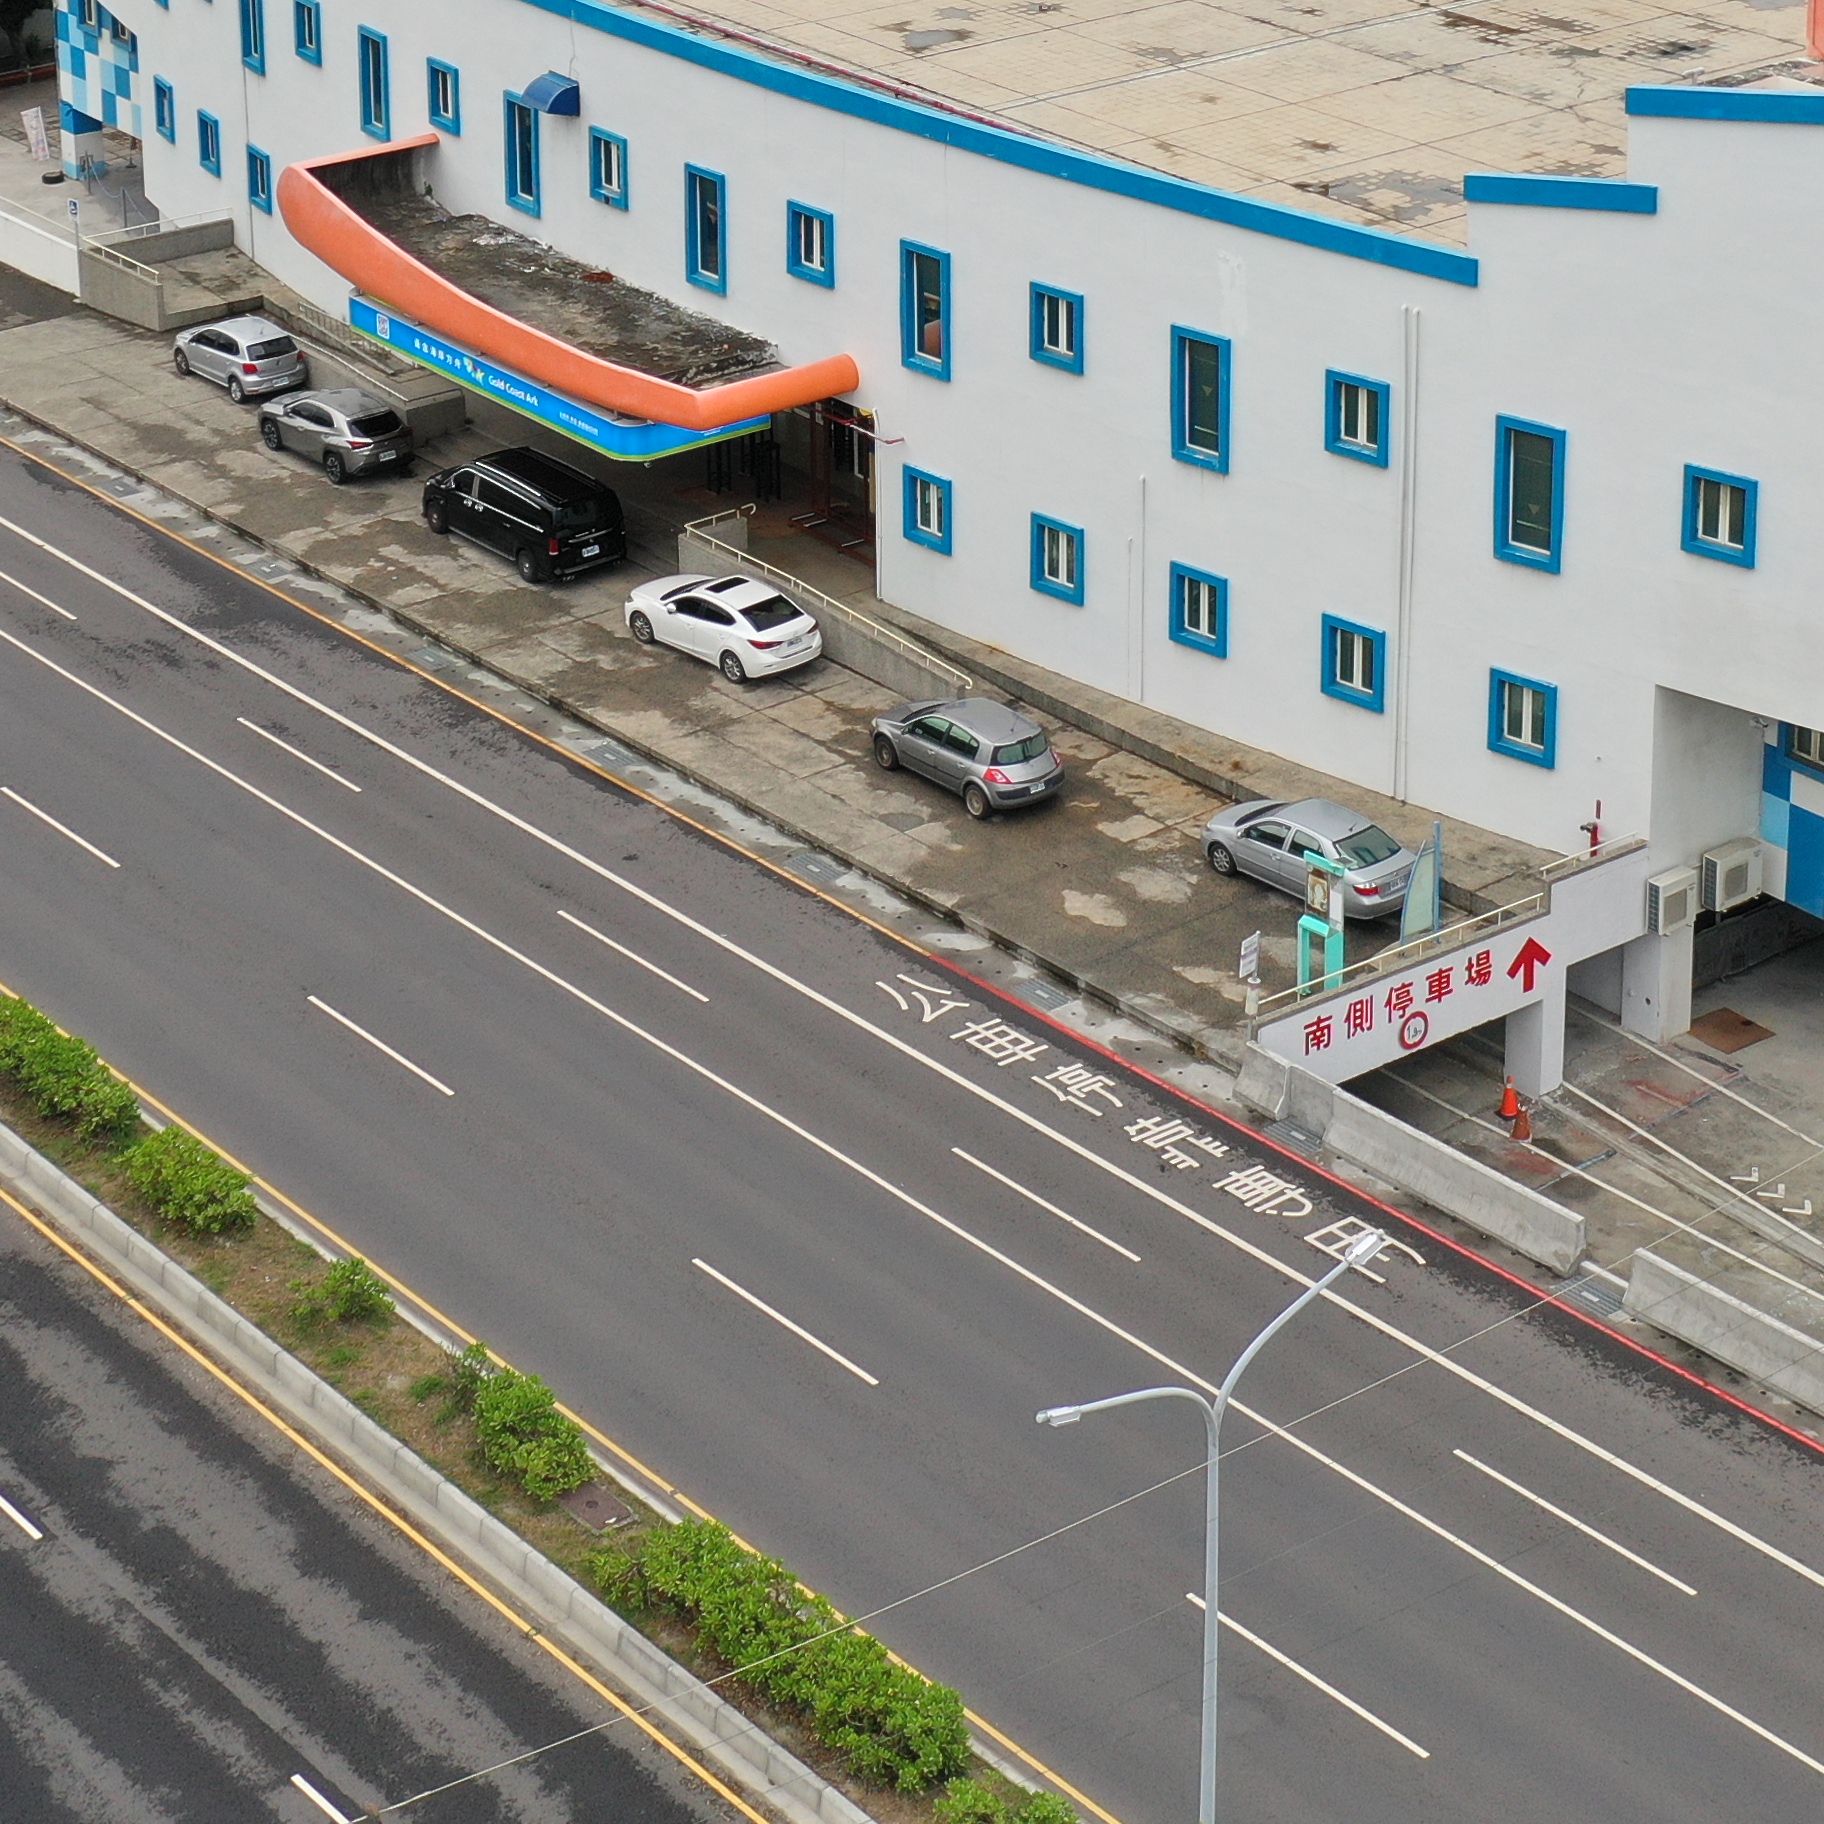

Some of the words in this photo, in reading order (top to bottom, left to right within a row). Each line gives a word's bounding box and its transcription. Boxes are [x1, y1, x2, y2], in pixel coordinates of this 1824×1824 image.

[488, 375, 505, 391] Gold
[506, 383, 525, 401] Coast
[526, 393, 539, 407] Ark
[1304, 949, 1493, 1055] 南側停車場
[875, 973, 1426, 1284] 公車停靠專用
